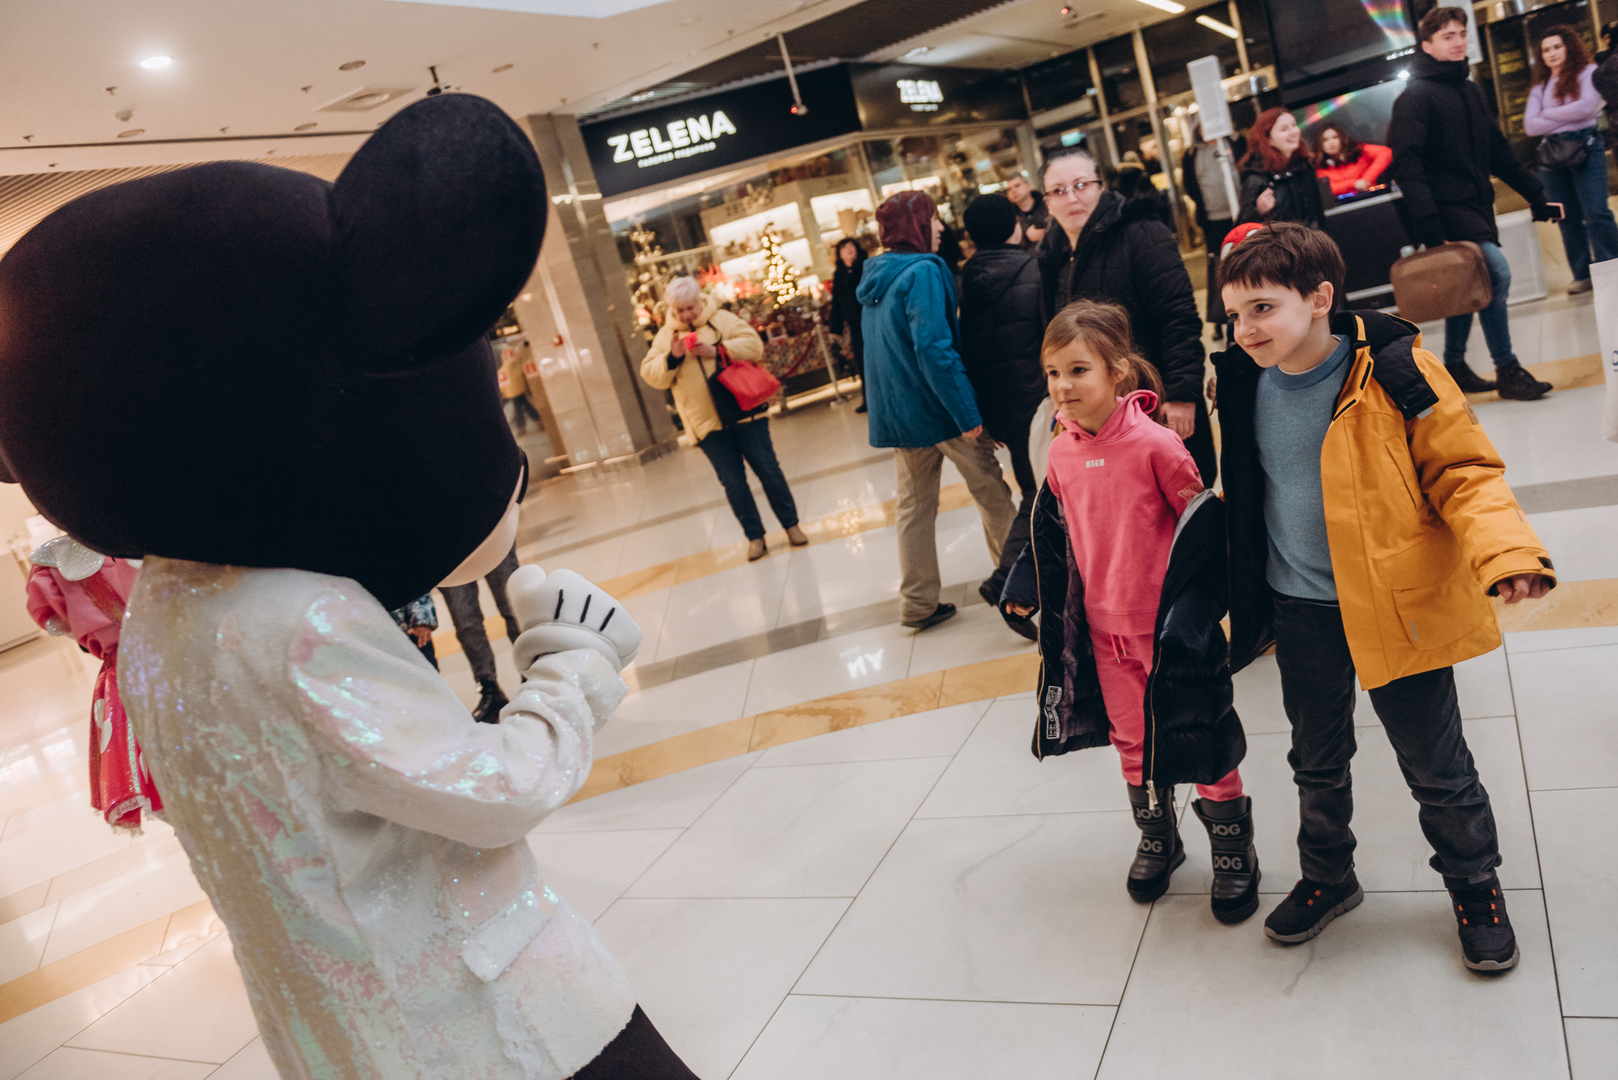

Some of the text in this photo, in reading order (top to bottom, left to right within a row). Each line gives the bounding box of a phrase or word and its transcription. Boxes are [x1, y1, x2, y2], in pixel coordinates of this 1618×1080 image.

[607, 110, 737, 164] ZELENA
[1135, 806, 1163, 820] JOG
[1211, 823, 1241, 836] JOG
[1213, 855, 1243, 871] DOG
